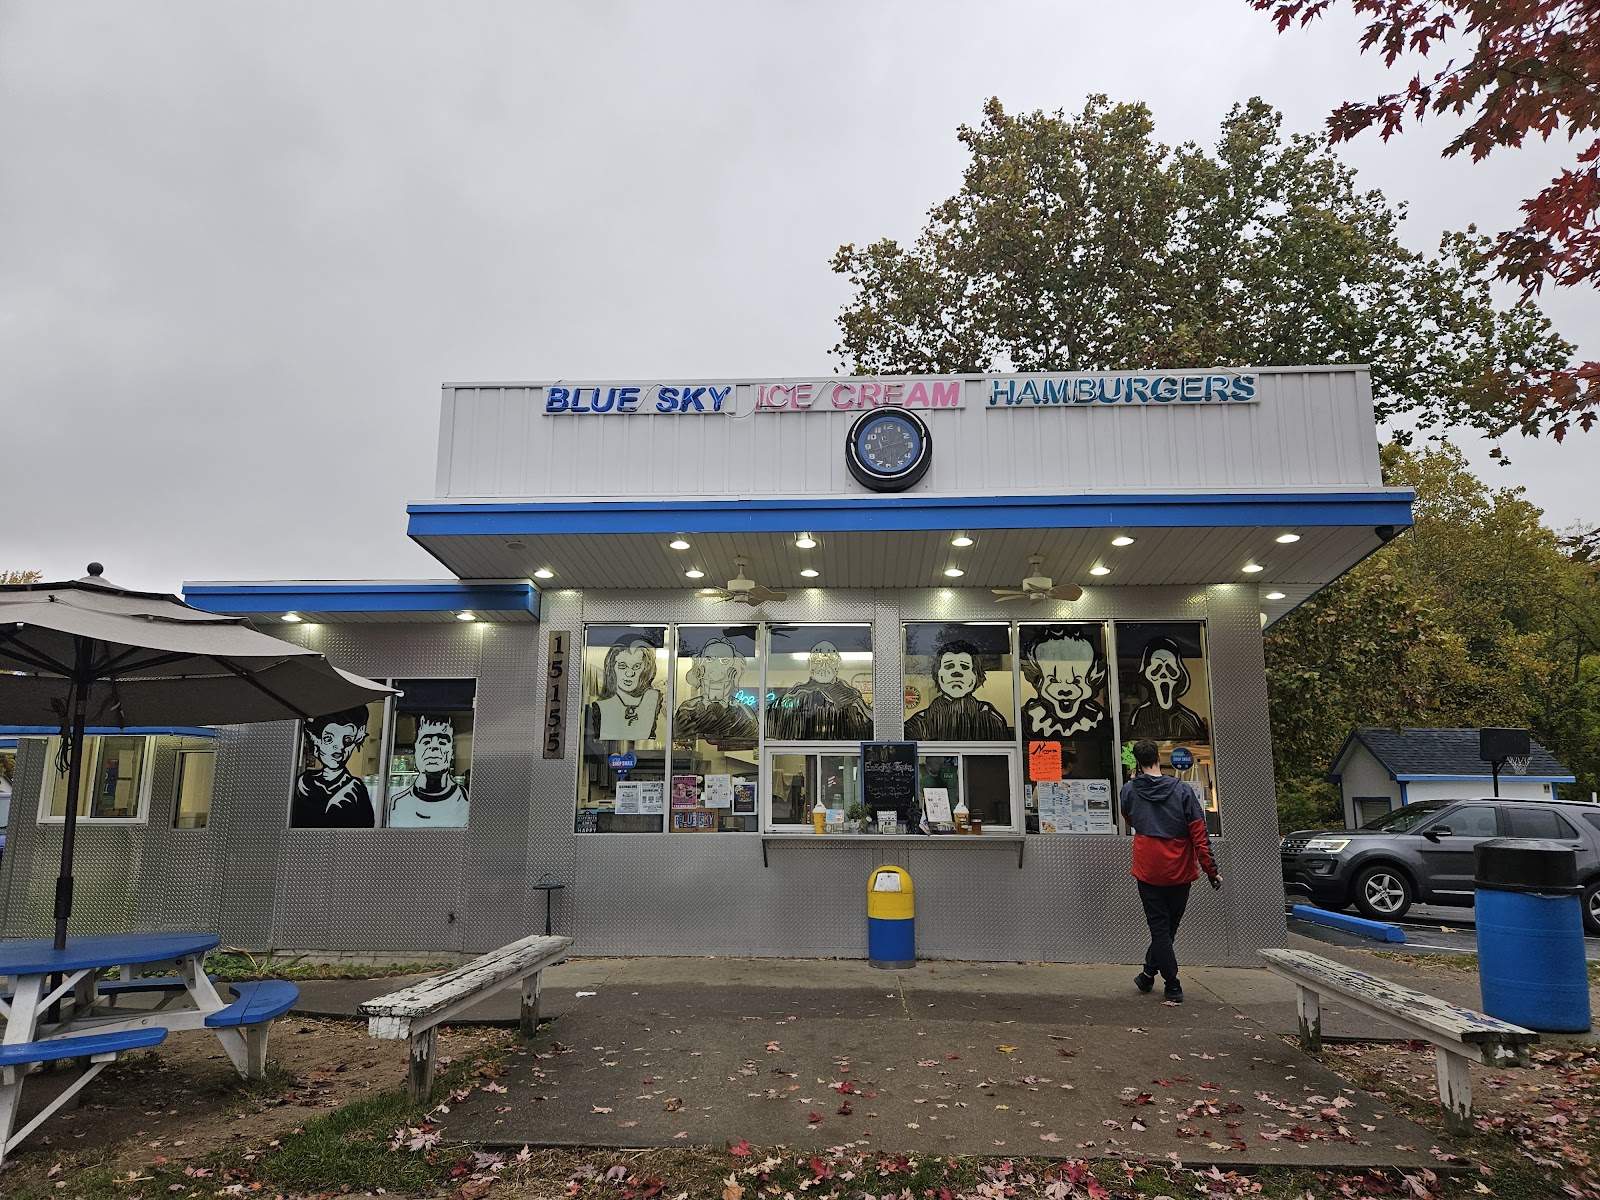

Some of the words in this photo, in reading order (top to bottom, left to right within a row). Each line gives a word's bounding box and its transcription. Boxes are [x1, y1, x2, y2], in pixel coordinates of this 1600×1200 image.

[546, 386, 641, 413] BLUE
[655, 386, 733, 413] SKY
[755, 383, 814, 411] ICE
[831, 380, 961, 411] CREAM
[989, 374, 1258, 406] HAMBURGERS
[546, 635, 564, 752] 15155
[699, 813, 714, 827] SKY
